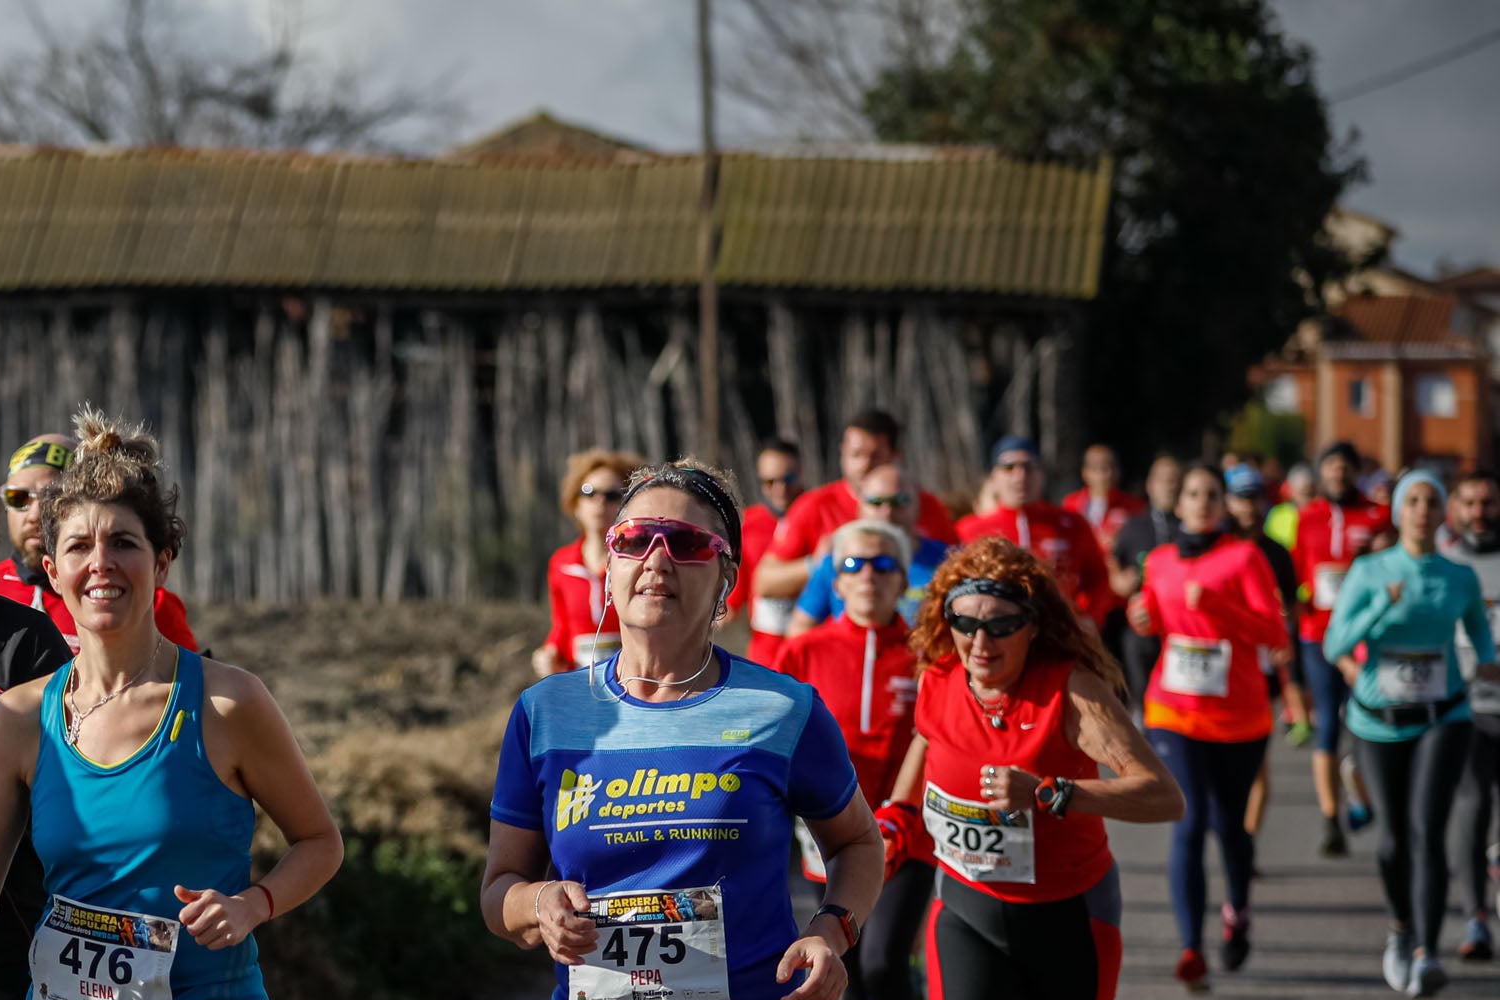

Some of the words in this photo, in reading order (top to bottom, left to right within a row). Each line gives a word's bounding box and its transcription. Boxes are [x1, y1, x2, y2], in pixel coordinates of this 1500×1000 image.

[605, 768, 741, 800] olimpo
[598, 800, 686, 820] deportes
[604, 830, 649, 845] TRAIL
[654, 829, 665, 841] &
[669, 828, 740, 841] RUNNING
[946, 821, 1004, 855] 202
[608, 896, 660, 908] CARRERA
[70, 907, 119, 926] CARRERA
[70, 917, 117, 933] POPULAR
[601, 925, 686, 968] 475
[59, 937, 135, 986] 476
[630, 969, 663, 986] PEPA
[79, 980, 115, 1000] ELENA
